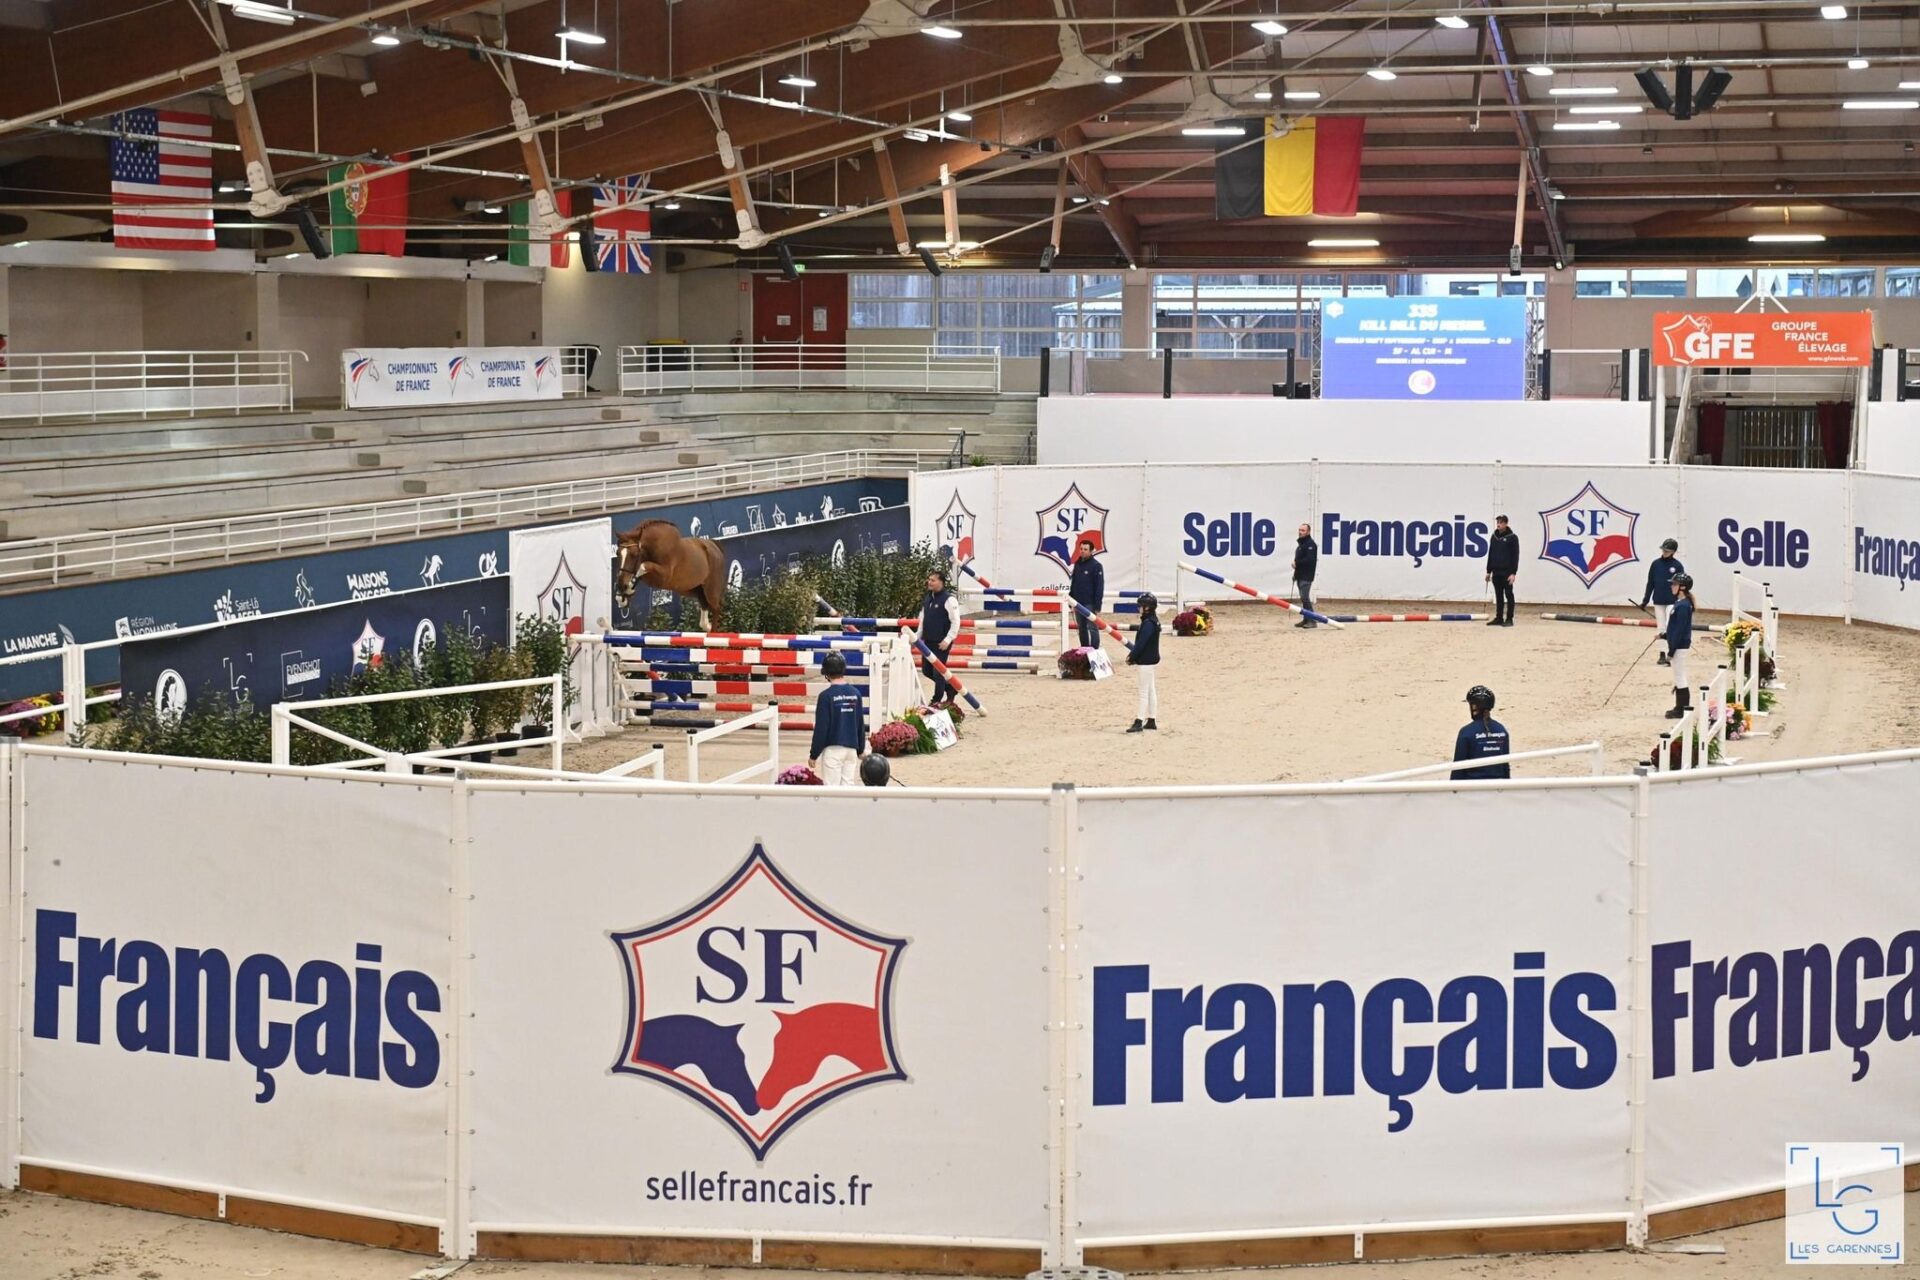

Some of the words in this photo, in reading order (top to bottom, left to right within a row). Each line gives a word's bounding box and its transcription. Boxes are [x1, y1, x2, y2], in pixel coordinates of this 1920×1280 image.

[1771, 321, 1817, 331] GROUPE
[1784, 332, 1829, 342] FRANCE
[1684, 332, 1754, 360] GFE
[1798, 342, 1848, 352] ÉLEVAGE
[388, 362, 438, 375] CHAMPIONNATS
[480, 360, 526, 373] CHAMPIONNATS
[395, 380, 405, 392] DE
[406, 379, 431, 391] FRANCE
[487, 377, 496, 388] DE
[496, 376, 521, 387] FRANCE
[946, 513, 965, 541] SF
[1056, 507, 1088, 533] SF
[1566, 508, 1610, 537] SF
[1183, 511, 1276, 558] Selle
[1321, 512, 1489, 569] Français
[1717, 517, 1810, 569] Selle
[551, 585, 573, 623] SF
[130, 616, 155, 628] RÉGION
[3, 639, 18, 653] LA
[18, 632, 59, 651] MANCHE
[695, 925, 818, 1004] SF
[33, 907, 442, 1104] Français
[1651, 929, 1920, 1083] França
[1092, 950, 1618, 1133] Français
[645, 1170, 873, 1206] sellefrancais.fr
